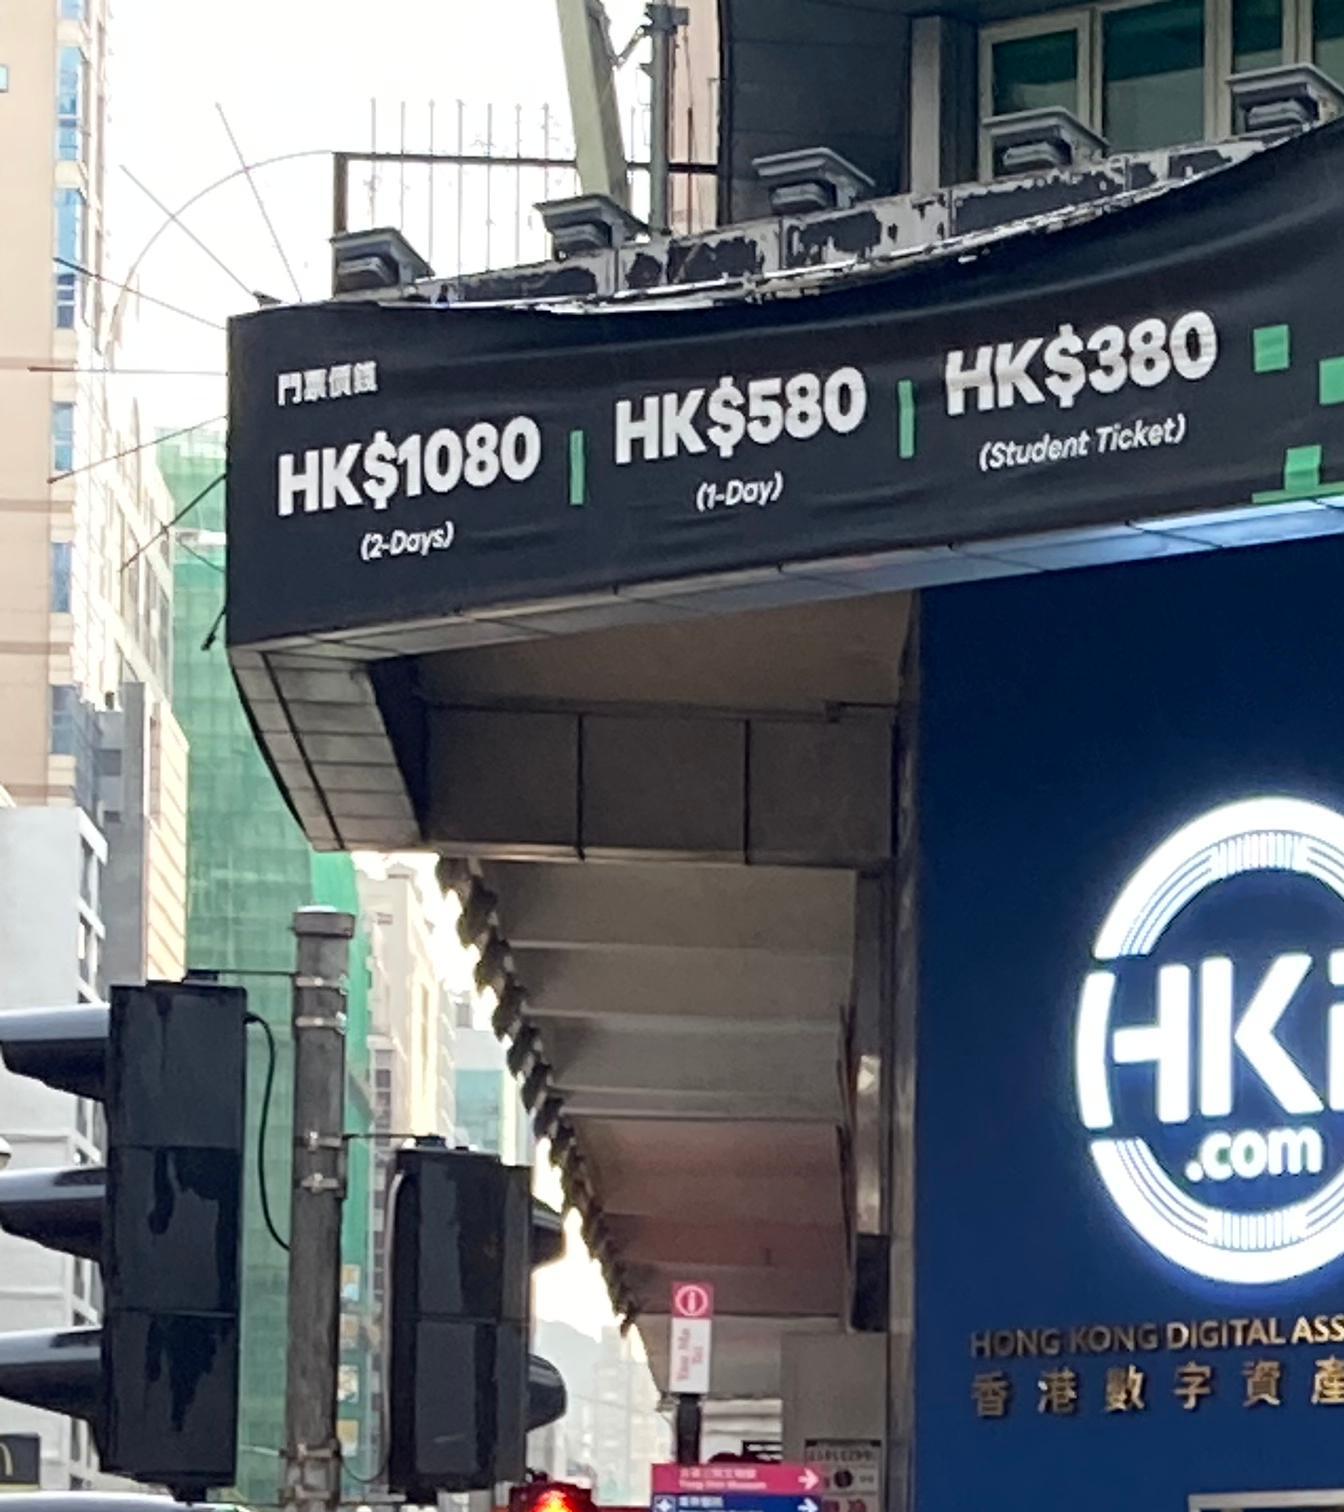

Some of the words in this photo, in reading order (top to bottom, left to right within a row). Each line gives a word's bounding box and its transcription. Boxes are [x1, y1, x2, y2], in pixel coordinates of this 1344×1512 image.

[944, 310, 1219, 417] HK$380
[616, 366, 867, 463] HK$580
[977, 428, 1089, 472] (Student
[1093, 411, 1185, 458] Ticket)
[278, 415, 541, 516] HK$1080
[696, 471, 784, 512] (1-Day)
[360, 520, 455, 561] (2-Days)
[1184, 1127, 1323, 1182] .com
[970, 1330, 1061, 1359] HONG
[1070, 1325, 1159, 1353] KONG
[1166, 1318, 1285, 1351] DIGITAL
